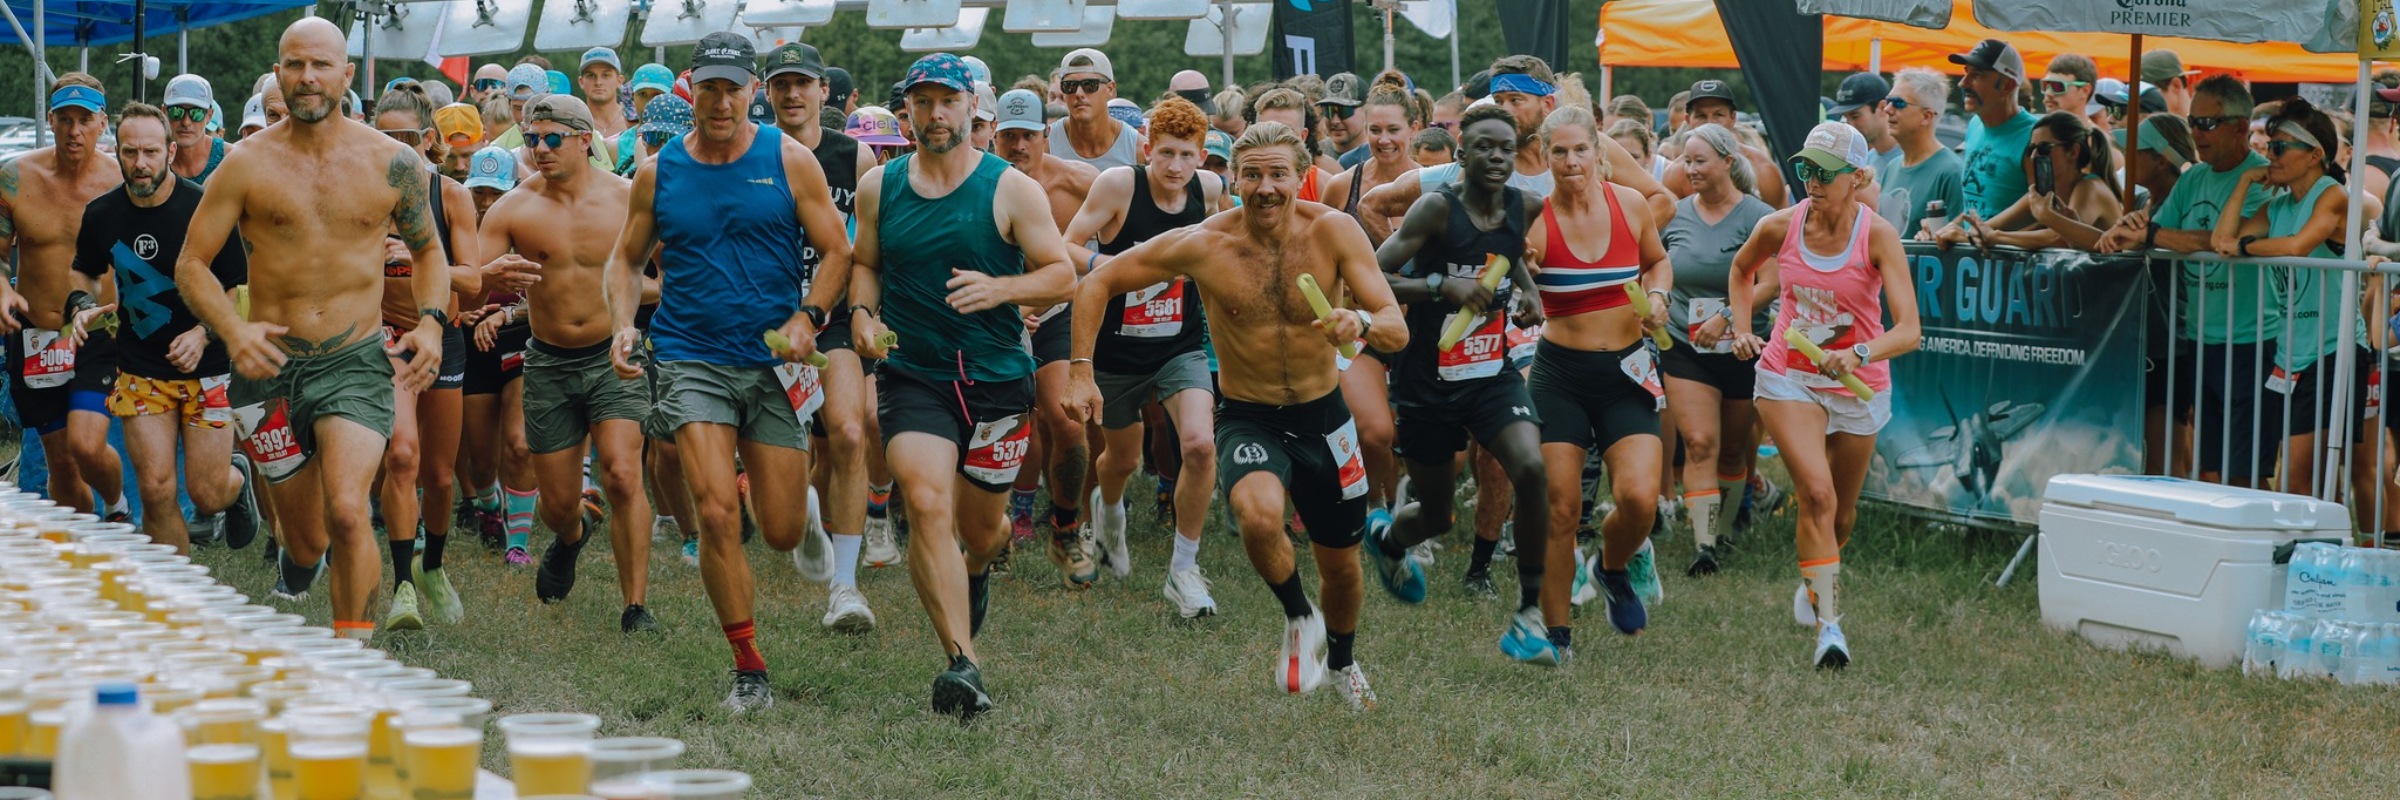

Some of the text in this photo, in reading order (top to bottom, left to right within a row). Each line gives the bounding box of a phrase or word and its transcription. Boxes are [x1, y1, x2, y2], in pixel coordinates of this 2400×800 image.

[2111, 11, 2191, 27] PREMIER
[1955, 255, 2086, 329] GUARD
[1144, 297, 1183, 318] 5581
[1463, 333, 1501, 356] 5577
[1973, 340, 2030, 361] DEFENDING
[40, 348, 75, 367] 5005
[250, 426, 296, 455] 5392
[993, 436, 1029, 462] 5376
